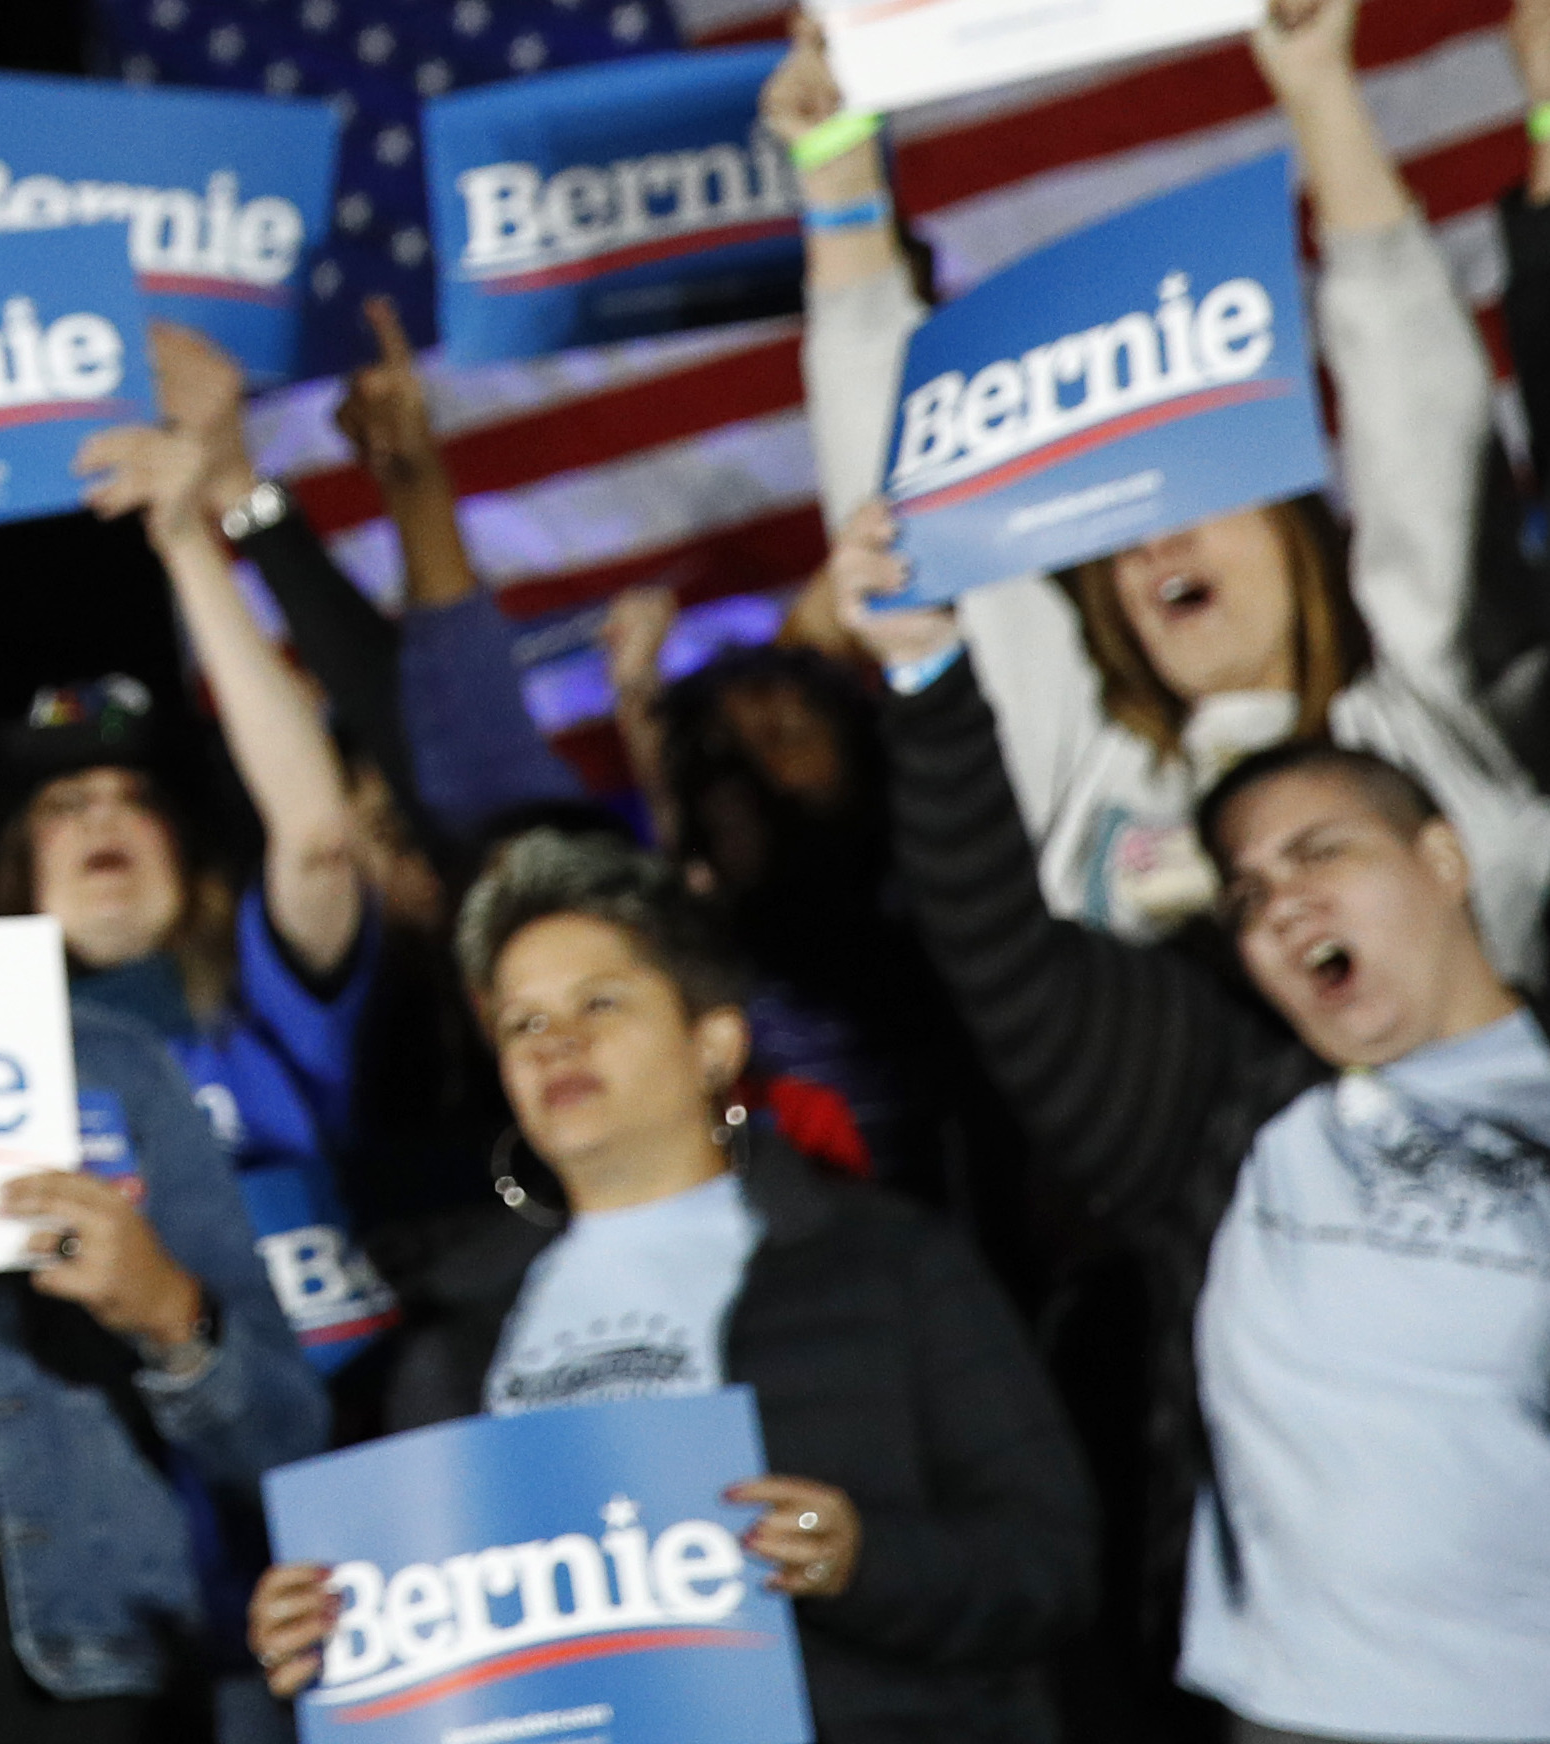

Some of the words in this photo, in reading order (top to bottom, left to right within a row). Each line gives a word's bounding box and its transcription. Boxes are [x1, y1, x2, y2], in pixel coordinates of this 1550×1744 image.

[456, 118, 799, 268] Berni
[890, 269, 1275, 483] Bernie
[323, 1491, 746, 1683] Bernie
